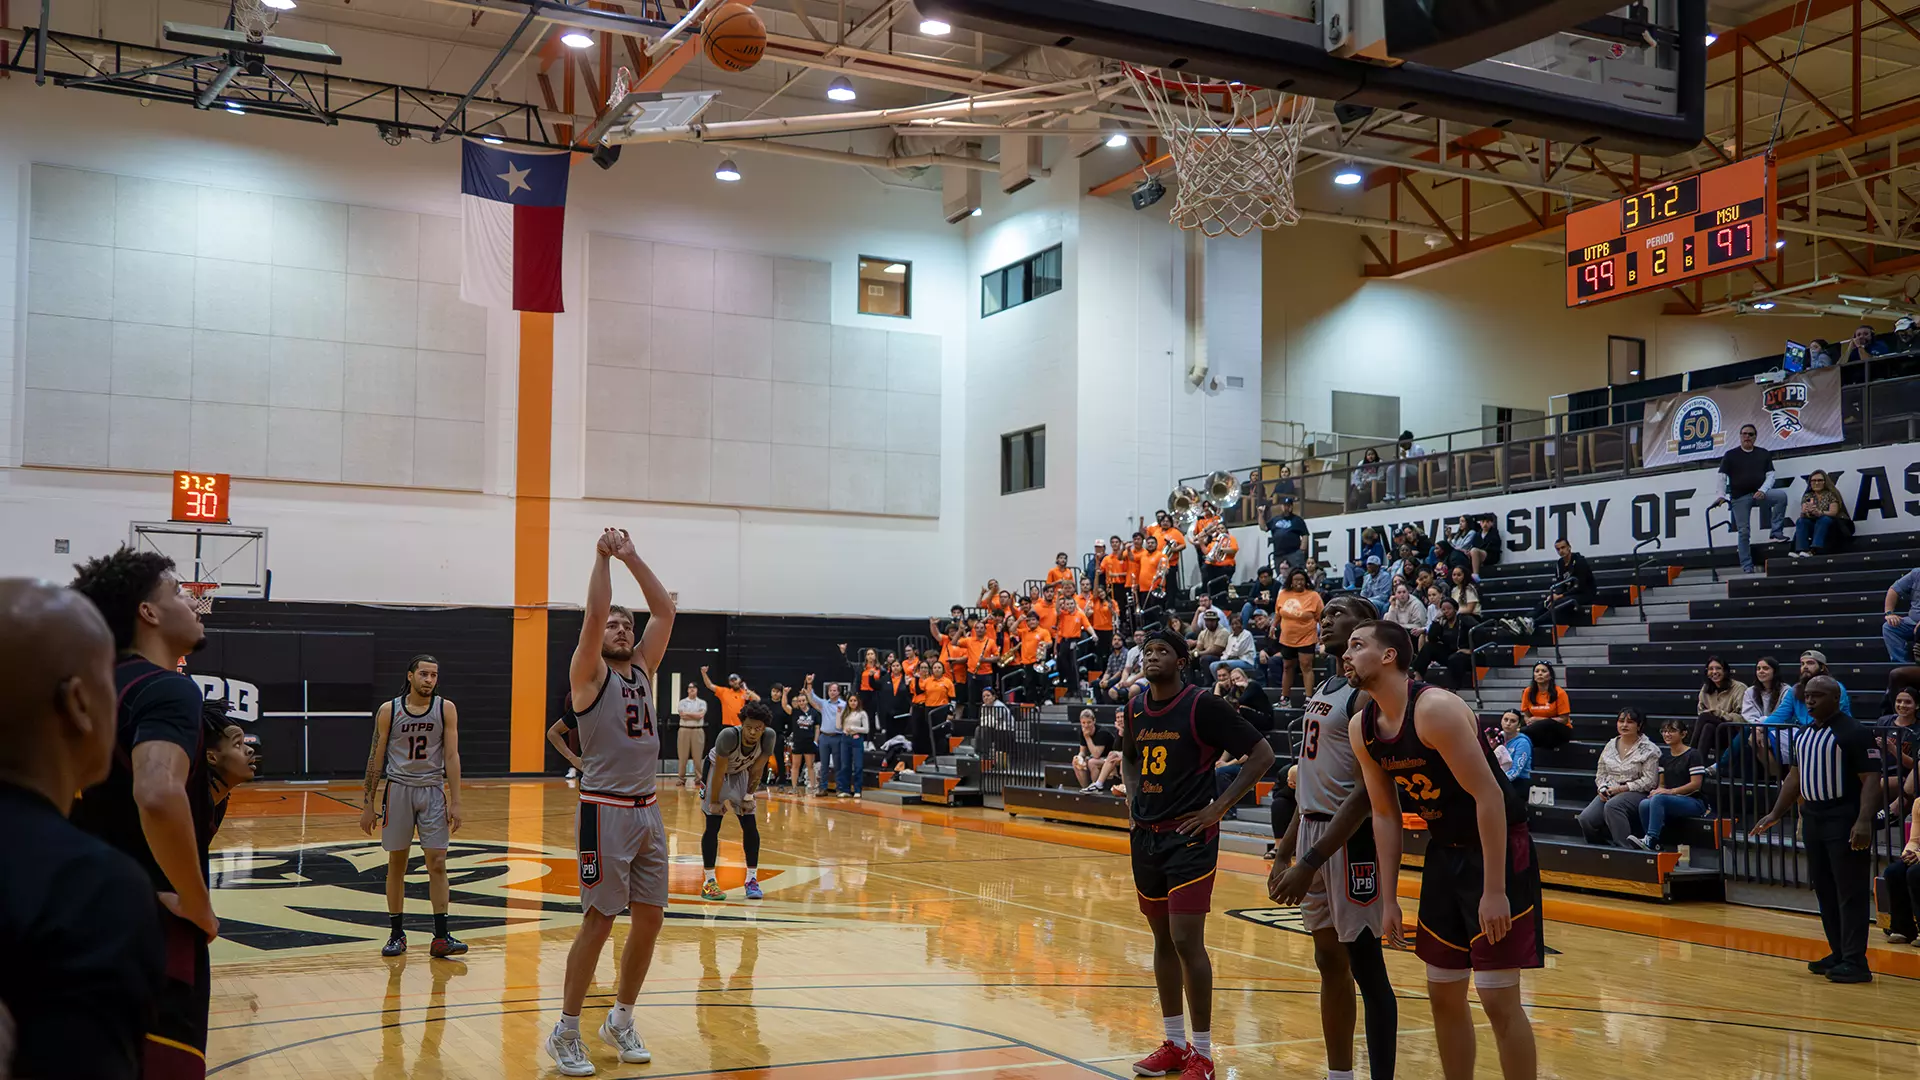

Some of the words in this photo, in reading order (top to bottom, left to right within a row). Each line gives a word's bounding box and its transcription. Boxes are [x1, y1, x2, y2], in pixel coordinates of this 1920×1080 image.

[1626, 185, 1679, 229] 37.2
[1716, 205, 1740, 225] MSU
[1584, 242, 1610, 261] UTPB
[1645, 232, 1675, 249] PERIOD
[1716, 223, 1751, 257] 97
[1654, 249, 1666, 274] 2
[1685, 255, 1693, 267] B
[1585, 260, 1614, 291] 99
[1628, 270, 1636, 281] B
[1766, 386, 1805, 405] UTPB
[1683, 416, 1709, 441] 50
[180, 474, 216, 491] 37.2
[186, 491, 218, 517] 30
[1631, 488, 1698, 542] OF
[401, 722, 435, 733] UTPB
[625, 702, 655, 739] 24
[407, 735, 428, 760] 12
[1300, 718, 1320, 761] 13
[1141, 745, 1168, 775] 13
[1394, 773, 1441, 800] 22
[583, 865, 595, 874] PB
[1354, 865, 1373, 877] UT
[1356, 877, 1373, 890] PB
